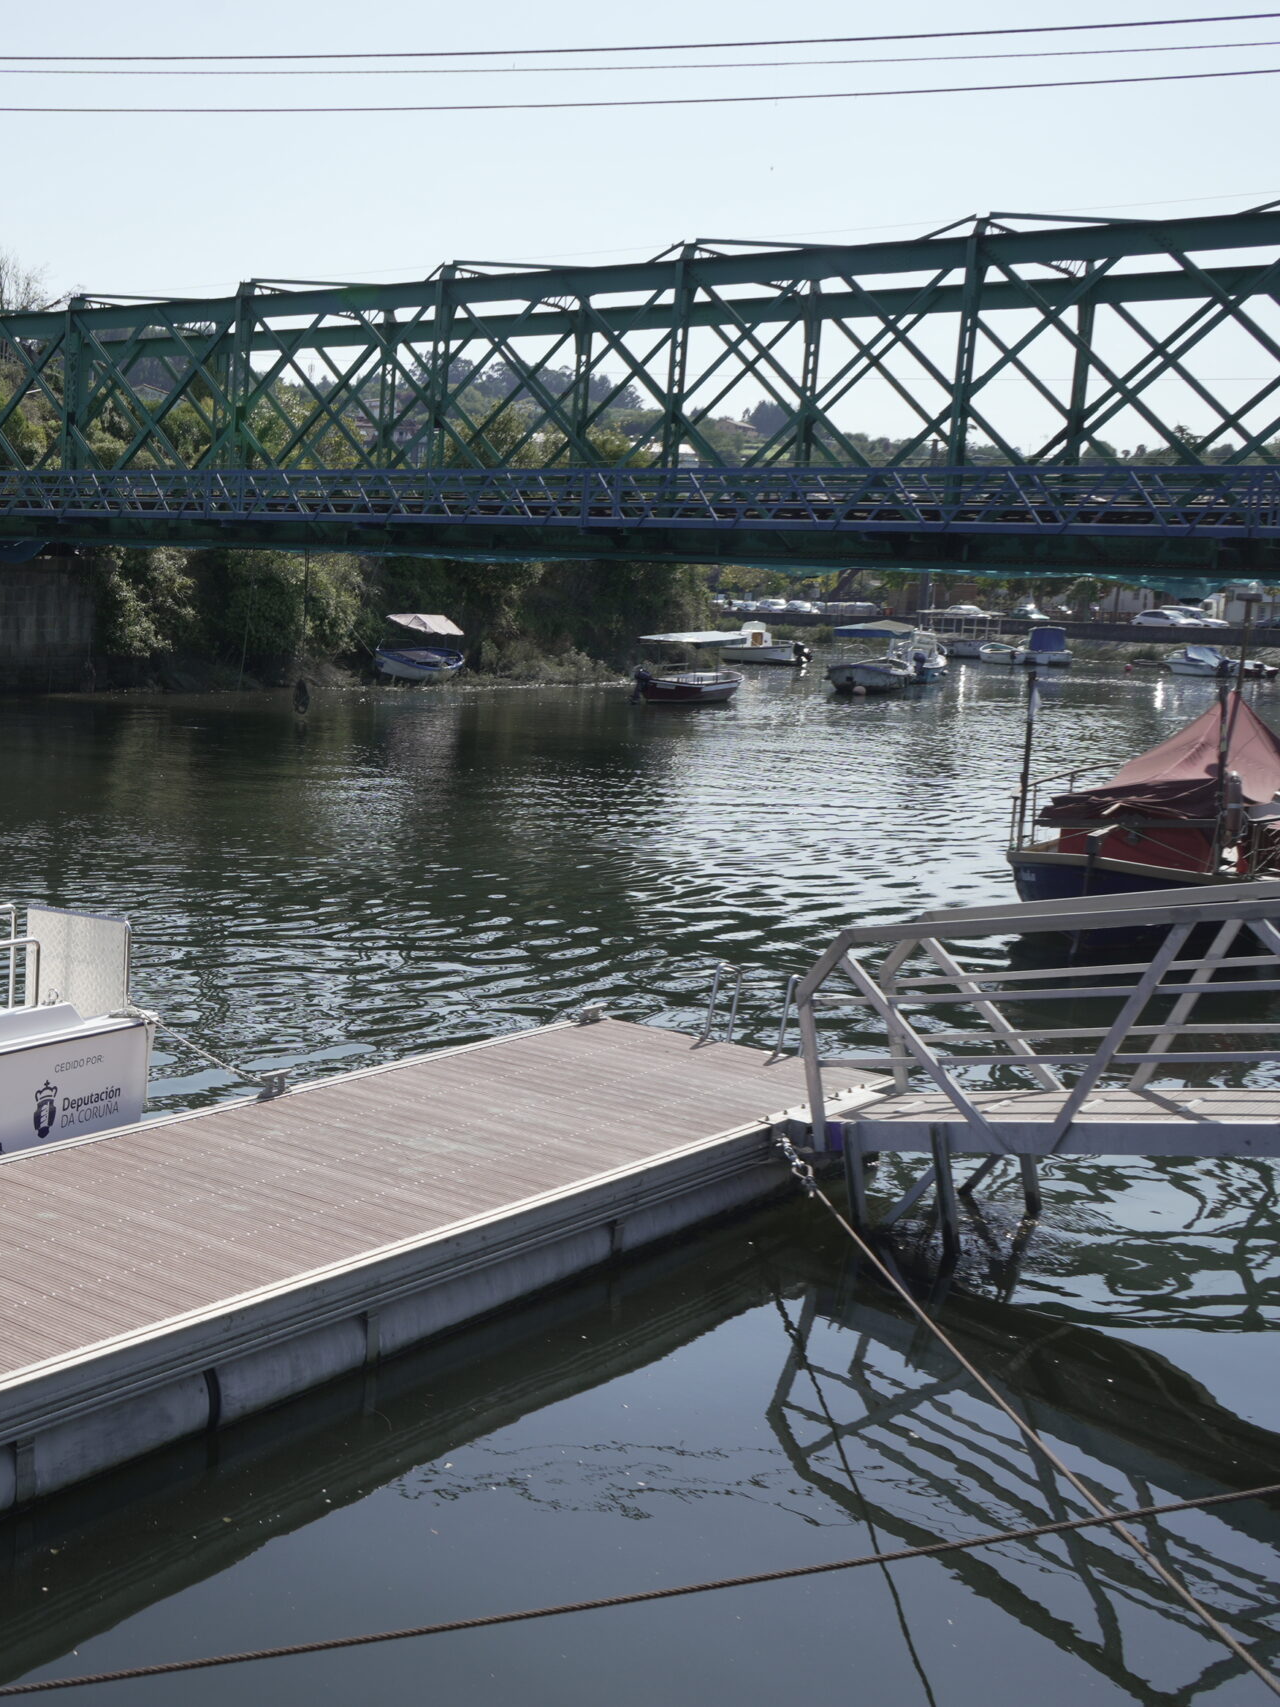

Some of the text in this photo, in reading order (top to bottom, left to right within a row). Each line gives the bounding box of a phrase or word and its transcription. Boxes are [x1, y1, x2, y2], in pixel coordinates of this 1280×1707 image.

[54, 1058, 85, 1073] CEDIDO
[62, 1085, 121, 1112] Deputación
[60, 1100, 119, 1128] DA CORUÑA
